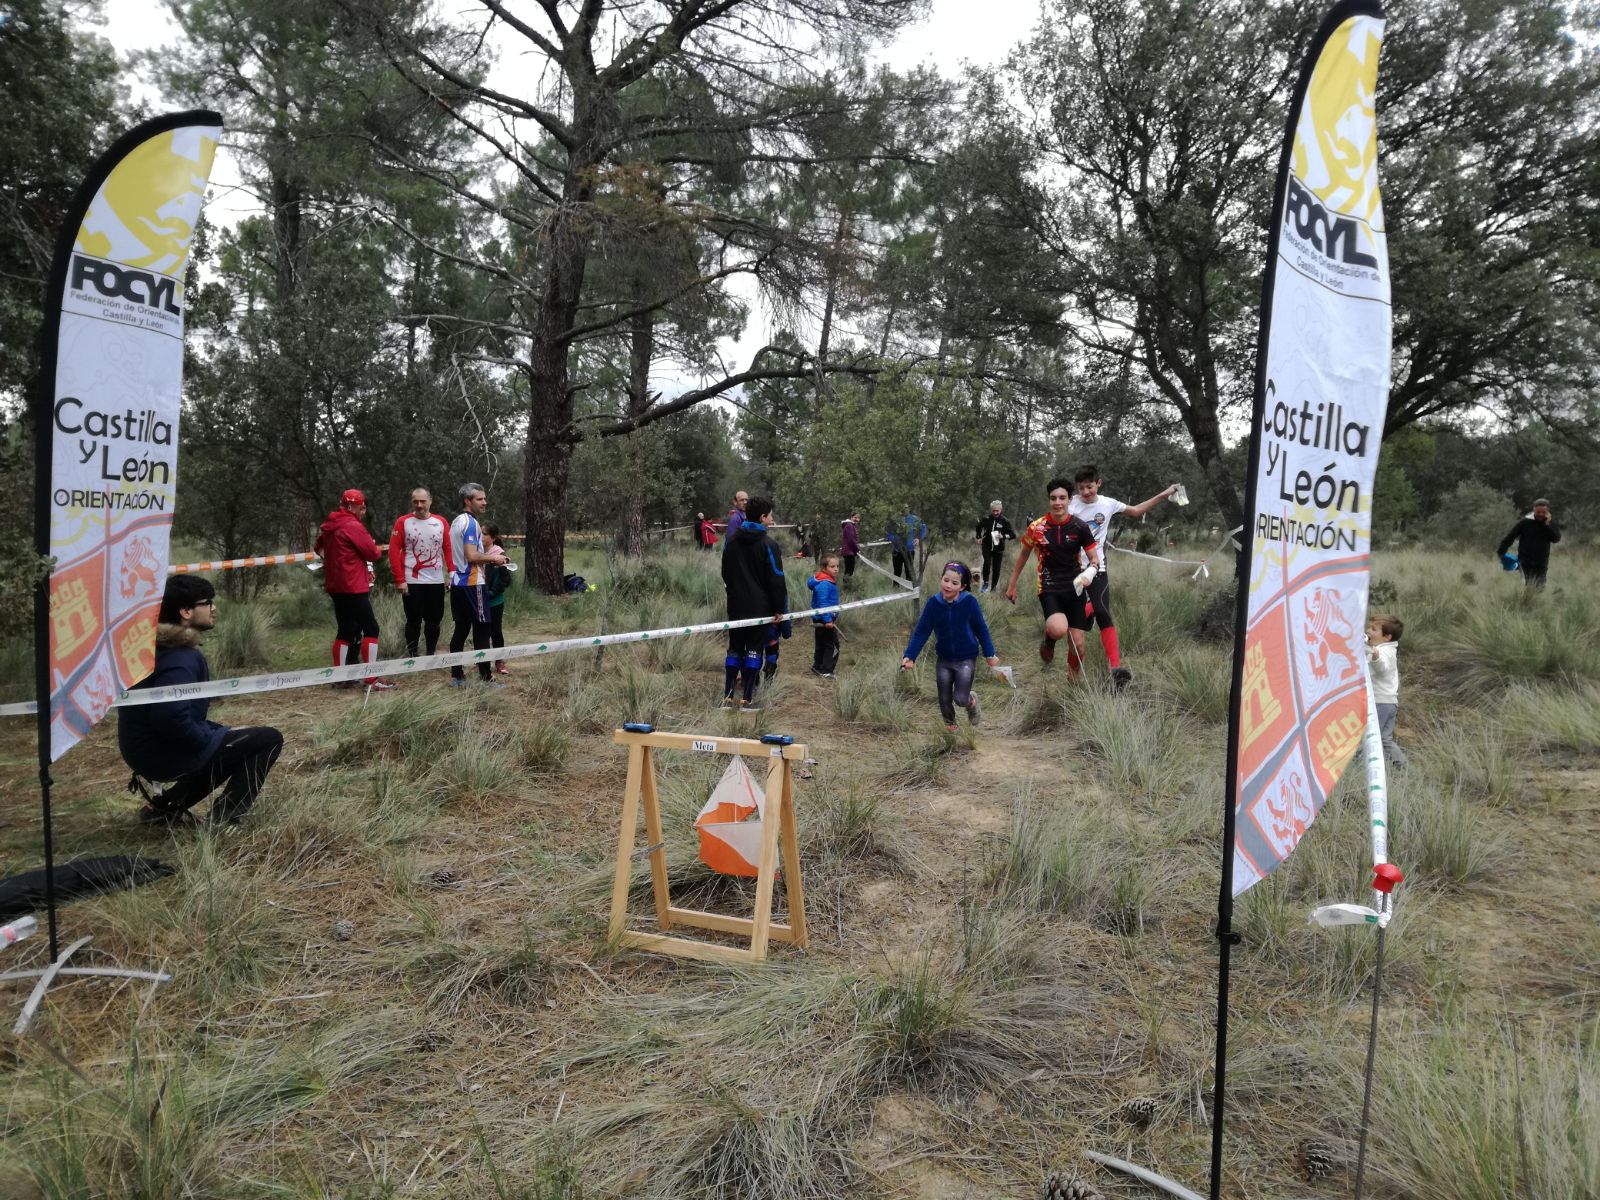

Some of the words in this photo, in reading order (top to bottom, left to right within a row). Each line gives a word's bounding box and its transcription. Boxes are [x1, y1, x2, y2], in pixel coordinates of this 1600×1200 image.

[70, 290, 121, 309] Federación
[124, 303, 135, 312] de
[138, 305, 180, 325] Orientac
[103, 309, 136, 323] Castilla
[146, 318, 164, 329] León
[54, 396, 172, 446] Castilla
[1263, 378, 1370, 458] Castilla
[79, 439, 97, 464] y
[101, 445, 169, 485] León
[1266, 440, 1280, 476] y
[1280, 450, 1360, 514] León
[54, 488, 165, 511] ORIENTACIÓN
[1256, 512, 1357, 552] RIENTACIÓN
[695, 741, 714, 751] Meta
